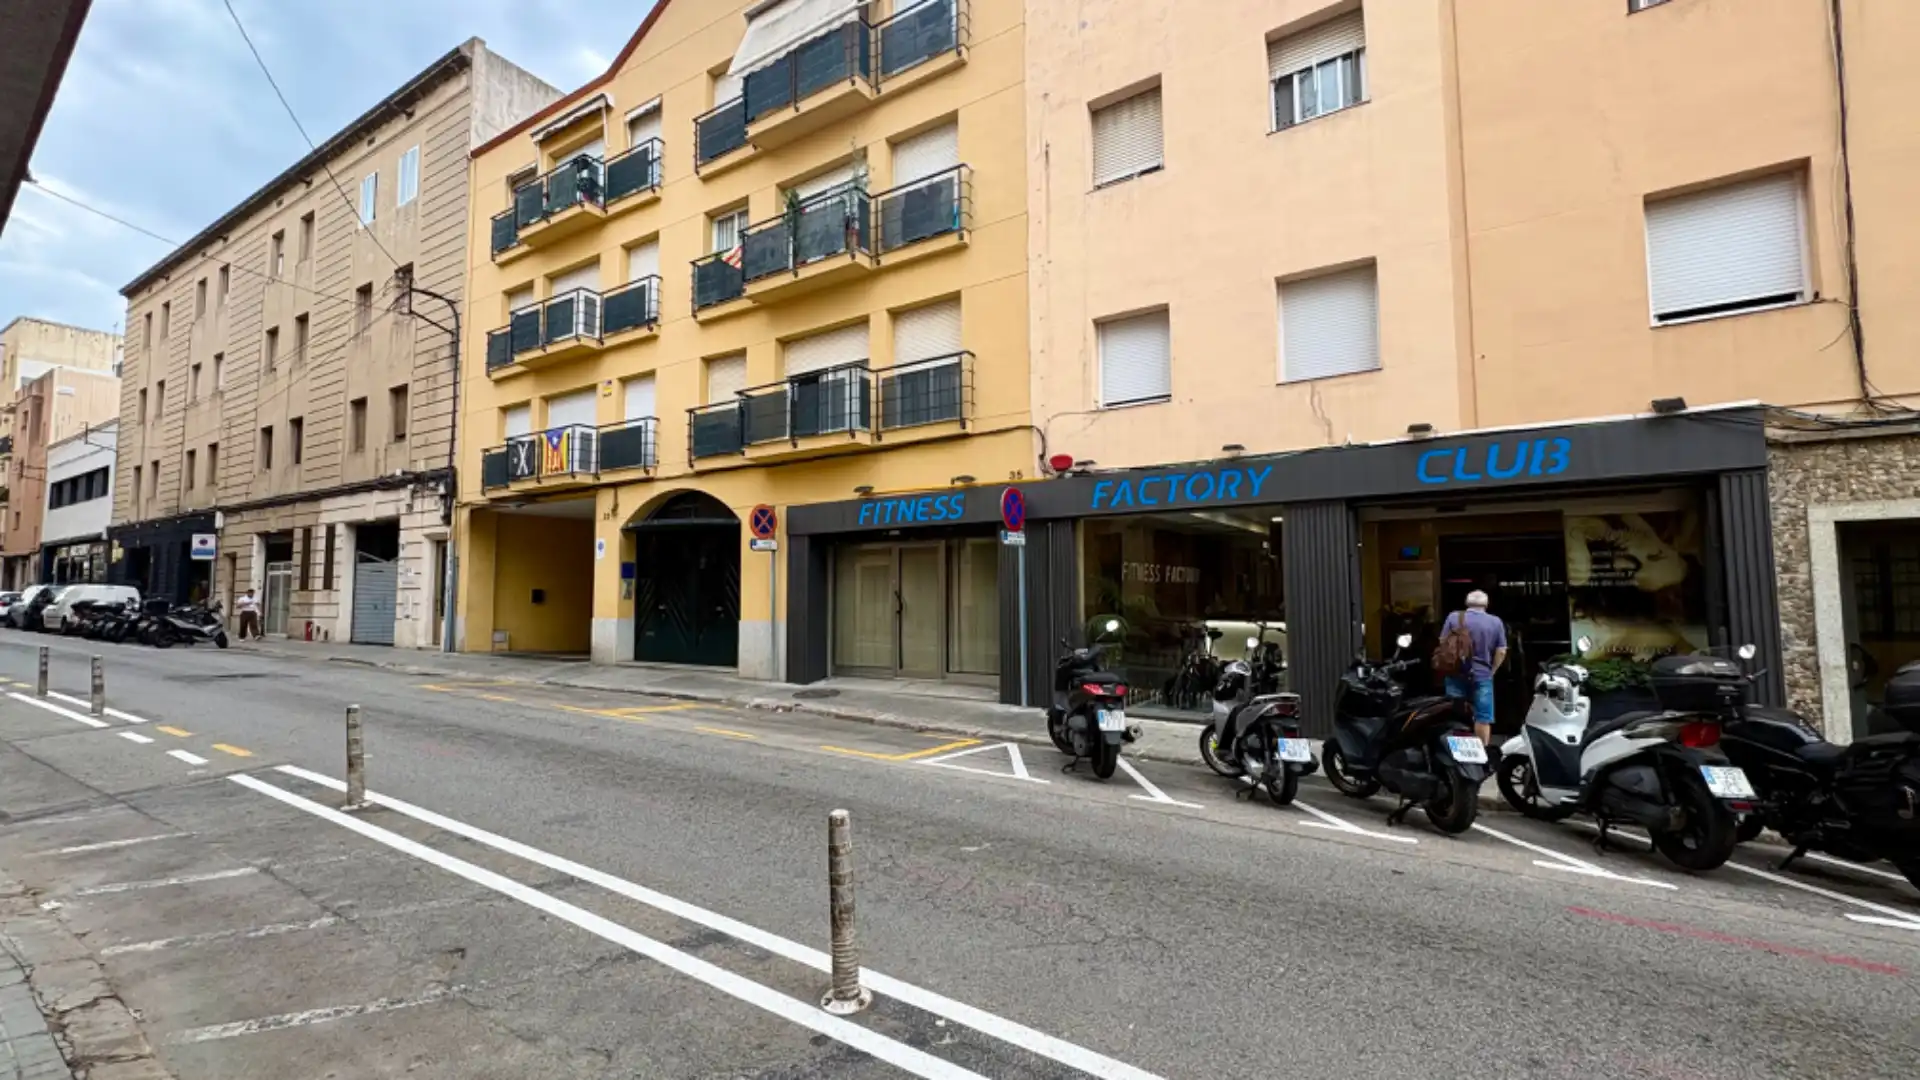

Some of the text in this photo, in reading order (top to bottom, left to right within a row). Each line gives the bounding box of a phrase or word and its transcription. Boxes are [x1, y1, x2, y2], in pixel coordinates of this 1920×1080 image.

[1416, 436, 1571, 484] CLUB
[858, 492, 966, 525] FITNESS
[1091, 465, 1273, 509] FACTORY
